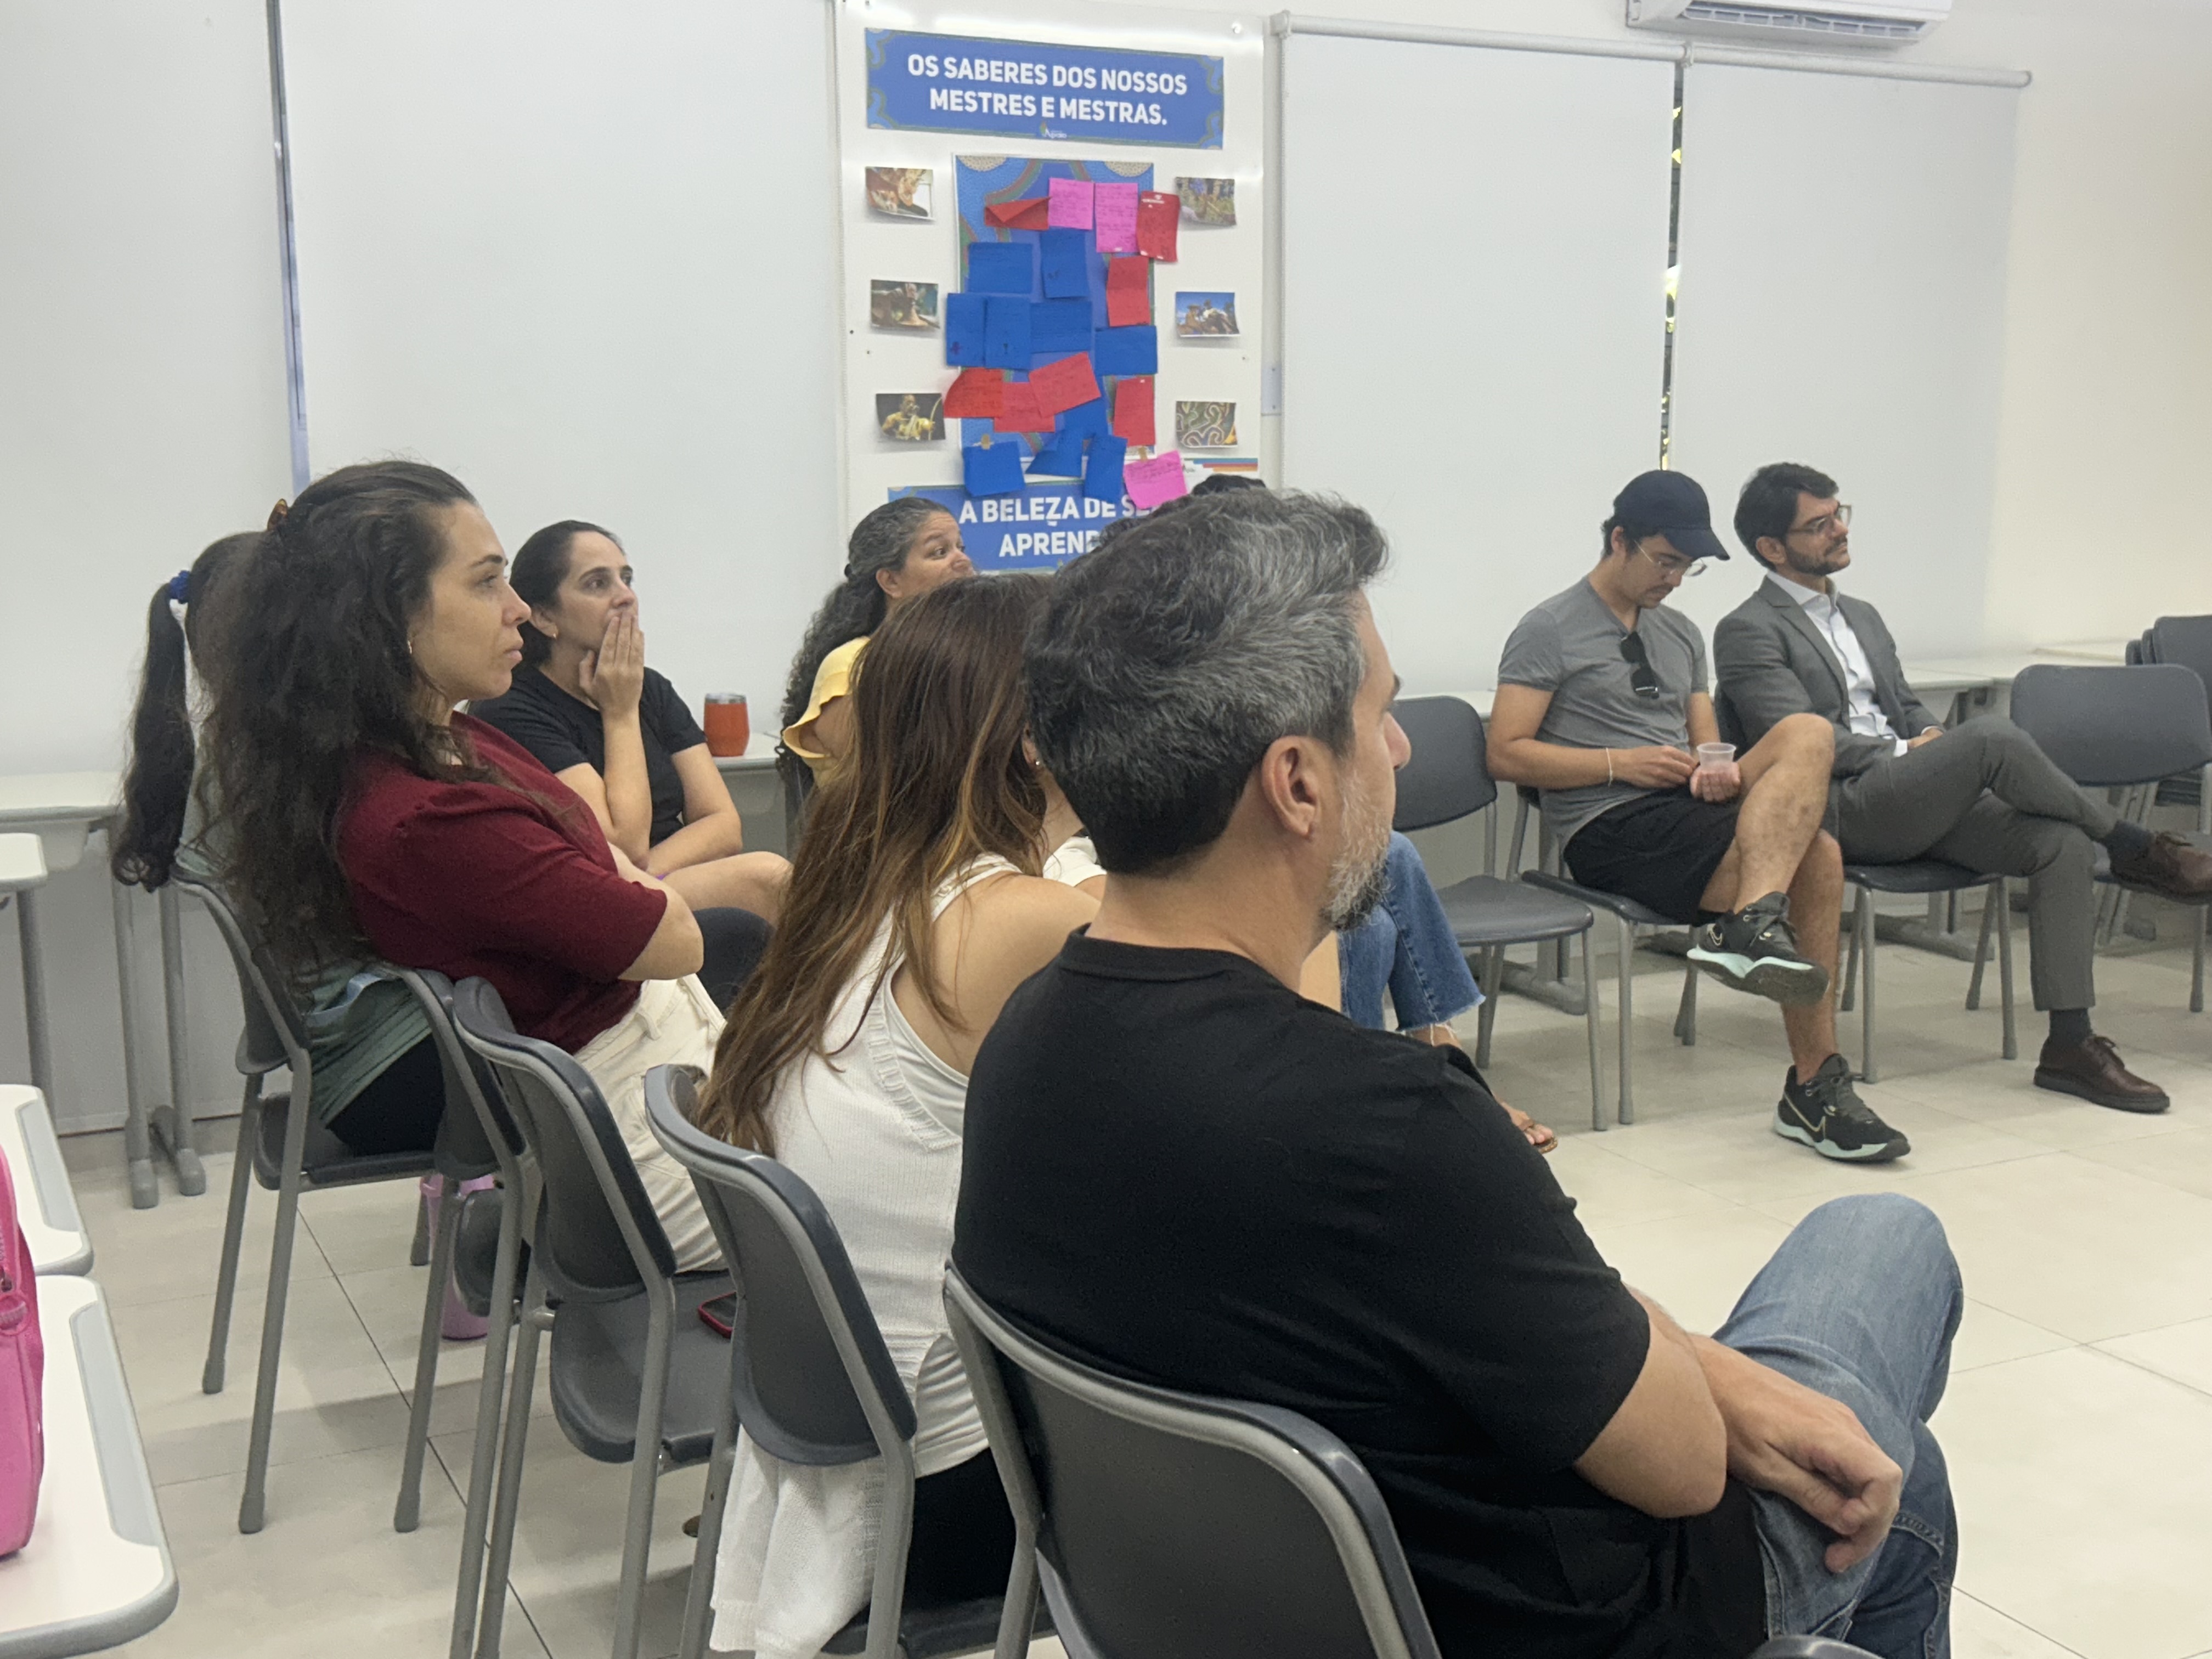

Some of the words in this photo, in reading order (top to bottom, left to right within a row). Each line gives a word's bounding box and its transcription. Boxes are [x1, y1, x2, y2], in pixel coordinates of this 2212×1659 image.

[907, 54, 939, 77] OS
[944, 57, 1048, 86] SABERES
[1053, 65, 1097, 89] DOS
[1101, 69, 1187, 96] NOSSOS
[930, 88, 1037, 117] MESTRES
[1041, 96, 1054, 118] E
[1059, 98, 1167, 126] MESTRAS.
[958, 500, 978, 524] A
[982, 496, 1080, 523] BELEZA
[1084, 497, 1116, 518] DE
